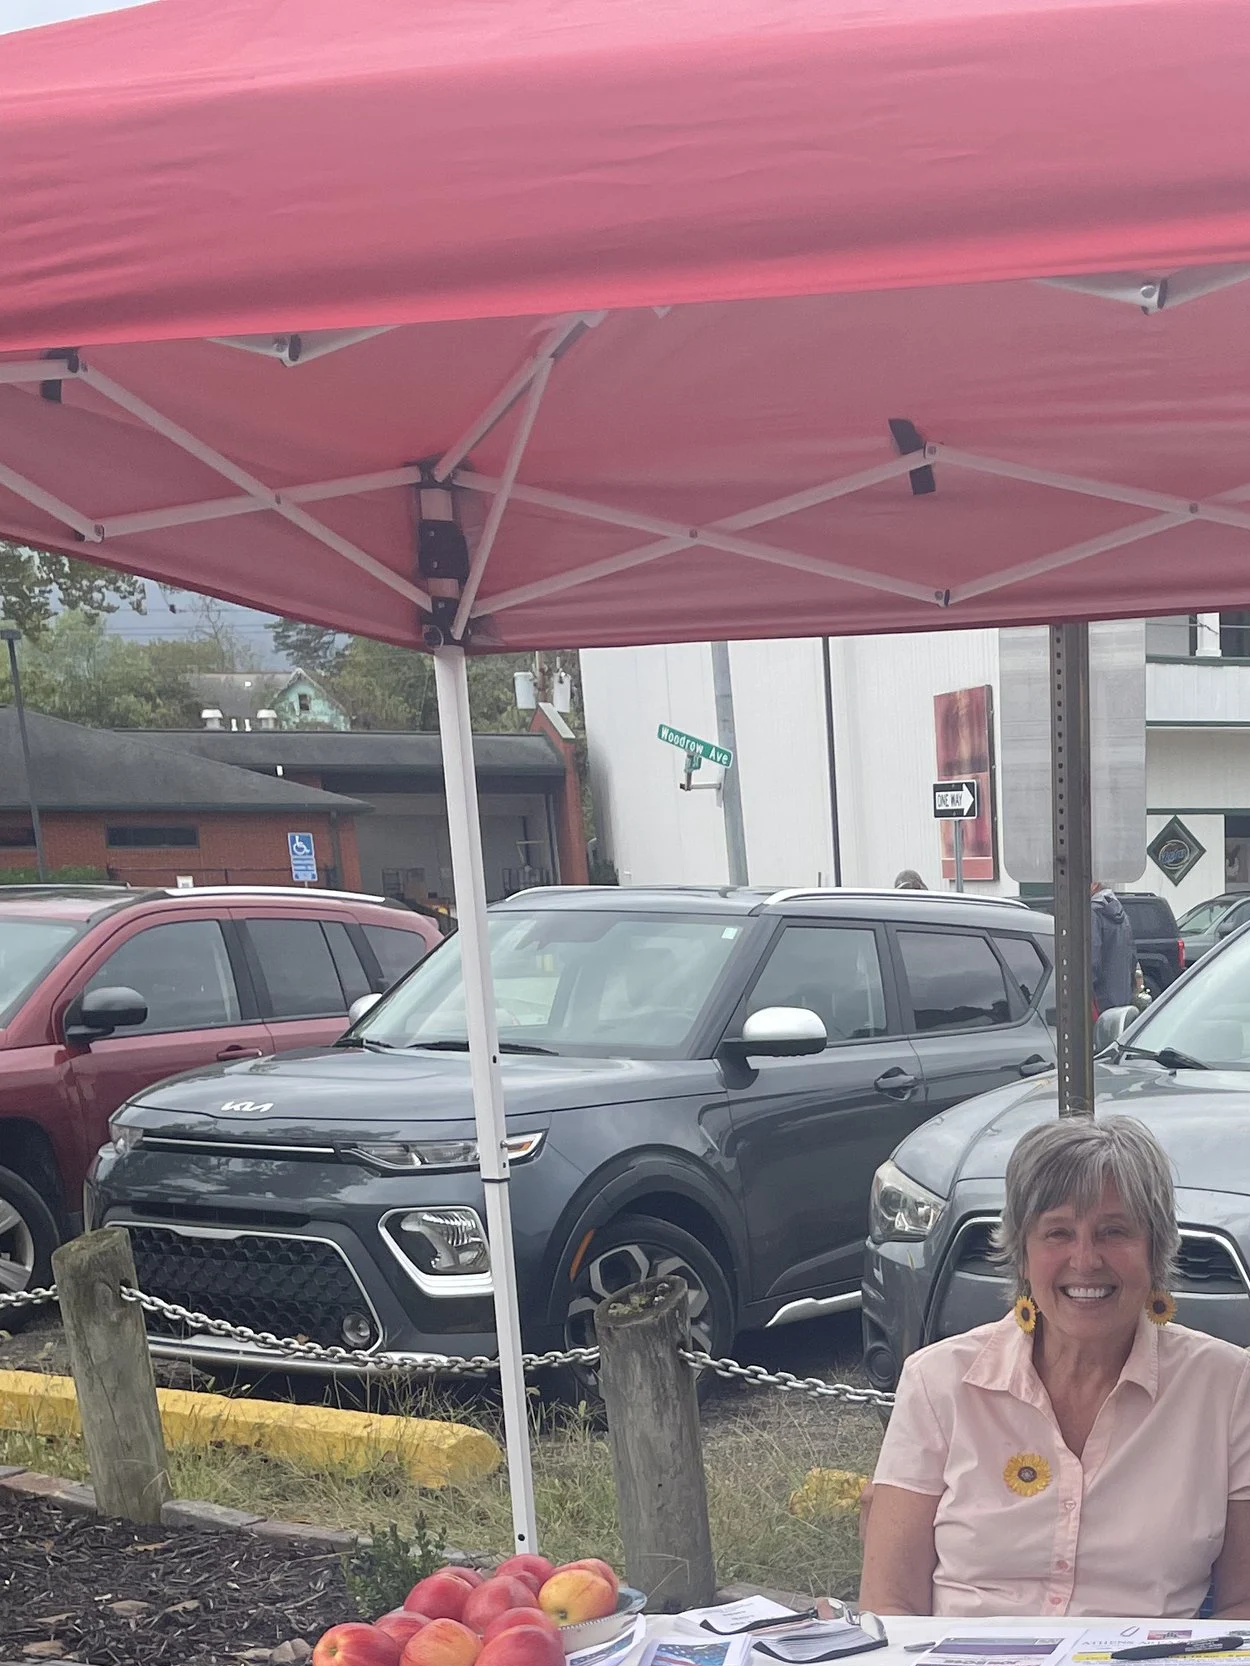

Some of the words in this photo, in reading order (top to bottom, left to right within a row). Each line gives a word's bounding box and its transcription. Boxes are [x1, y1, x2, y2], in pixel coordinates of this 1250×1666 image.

[660, 726, 704, 754] Woodrow
[708, 747, 729, 765] Ave
[937, 793, 950, 807] ONE
[950, 793, 963, 807] WAY
